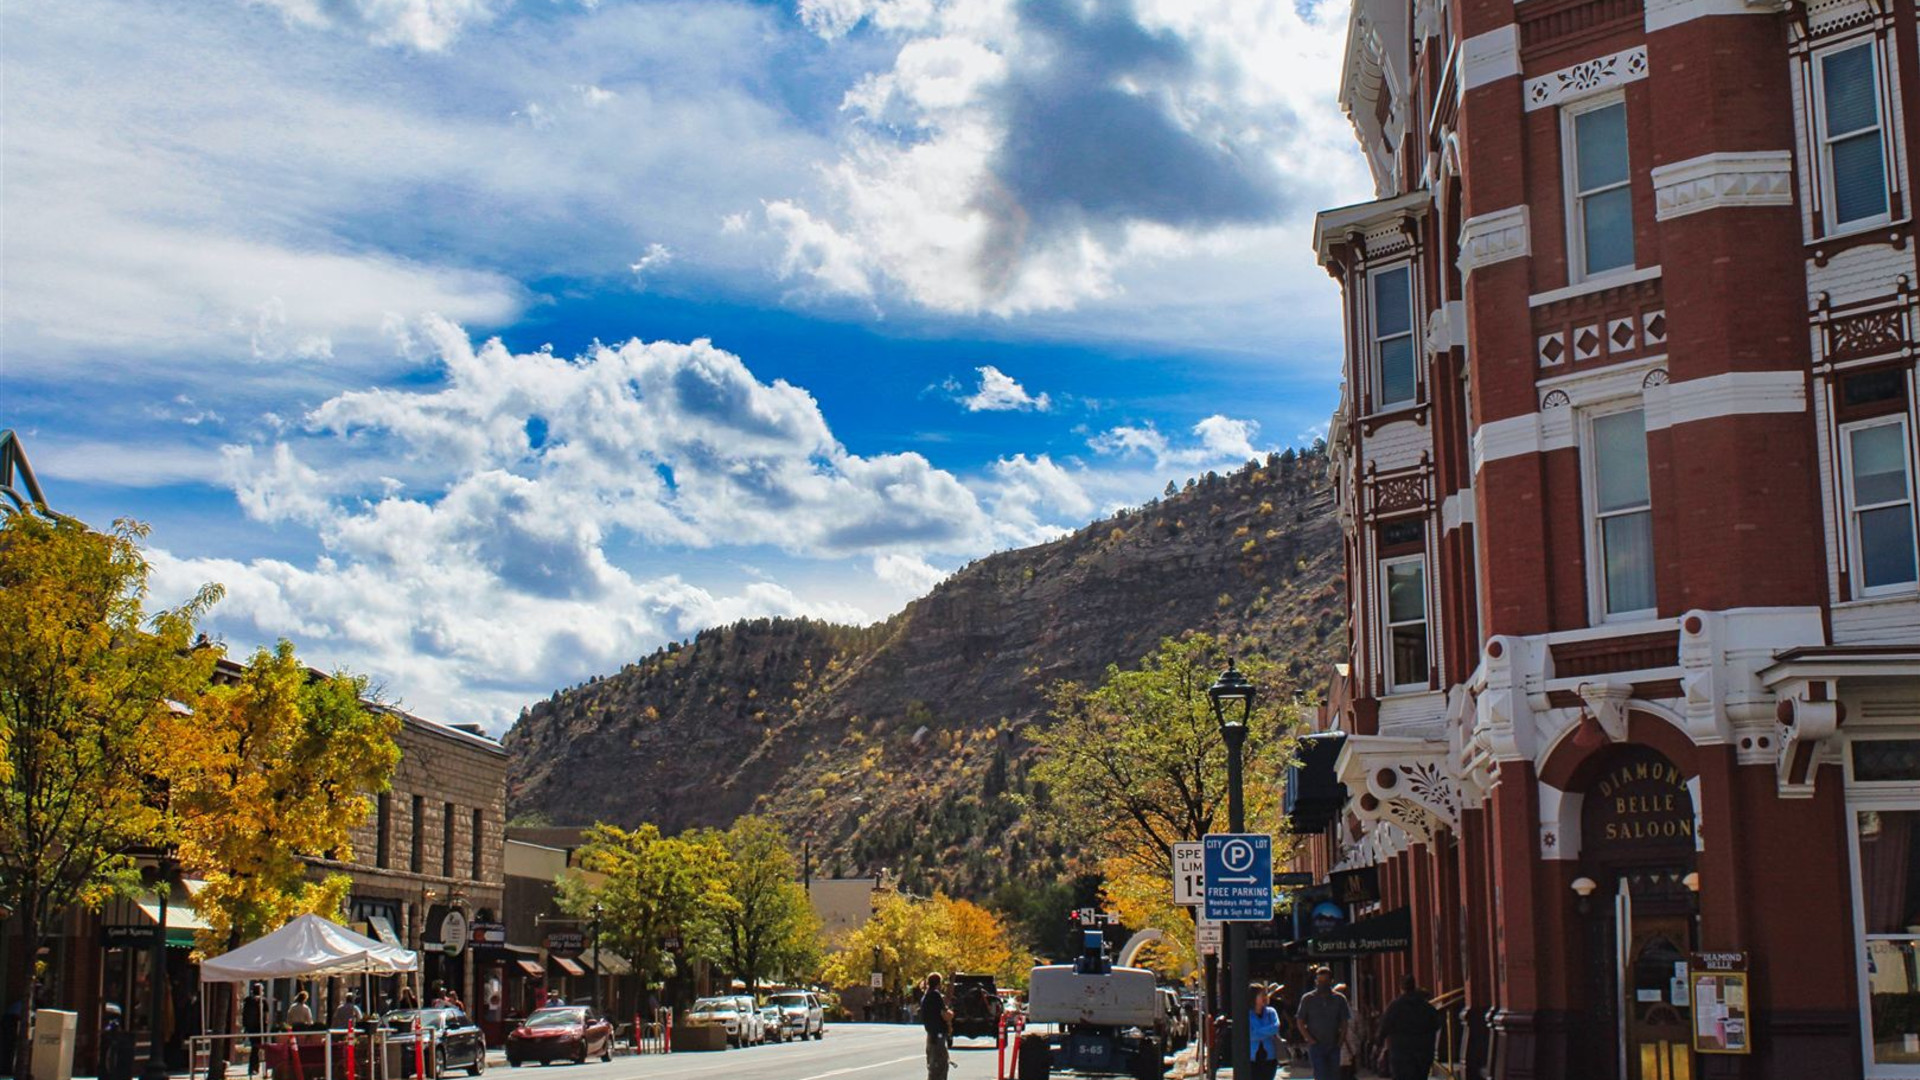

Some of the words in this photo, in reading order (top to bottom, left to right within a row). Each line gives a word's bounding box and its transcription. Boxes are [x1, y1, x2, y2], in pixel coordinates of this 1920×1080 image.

[1616, 794, 1674, 814] BELLE
[1605, 819, 1692, 840] SALOON
[1177, 849, 1202, 859] SPE
[1206, 839, 1222, 849] CITY
[1231, 846, 1245, 865] P
[1255, 840, 1268, 849] LOT
[1181, 862, 1203, 872] LIM
[1208, 887, 1230, 897] FREE
[1232, 887, 1269, 897] PARKING
[1208, 899, 1237, 907] Weekdays
[1212, 908, 1222, 916] Sat
[1231, 908, 1242, 916] Sun
[1253, 908, 1265, 917] Day
[1317, 939, 1346, 952] Spirits
[1349, 939, 1357, 948] &
[1359, 937, 1408, 950] Appetizers
[1703, 953, 1742, 962] DIAMOND
[1079, 1045, 1104, 1055] S-65
